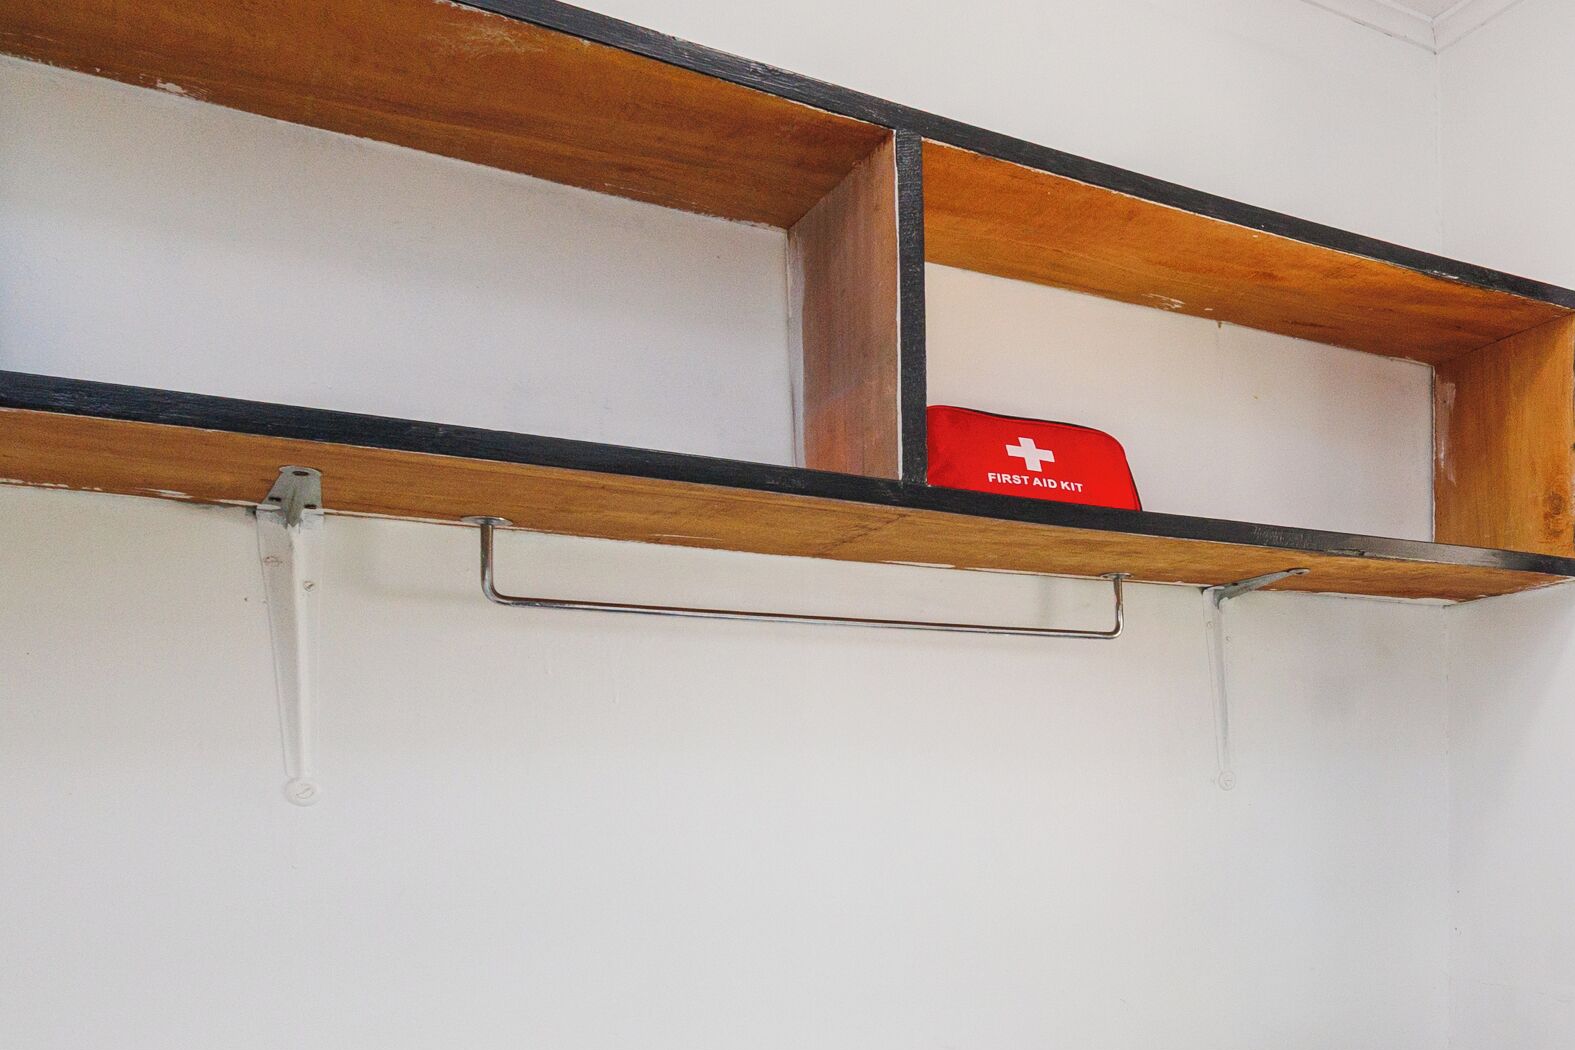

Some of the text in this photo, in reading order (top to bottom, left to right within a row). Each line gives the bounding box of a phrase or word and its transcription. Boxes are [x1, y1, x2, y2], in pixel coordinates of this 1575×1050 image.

[988, 472, 1084, 493] FIRST AID KIT
